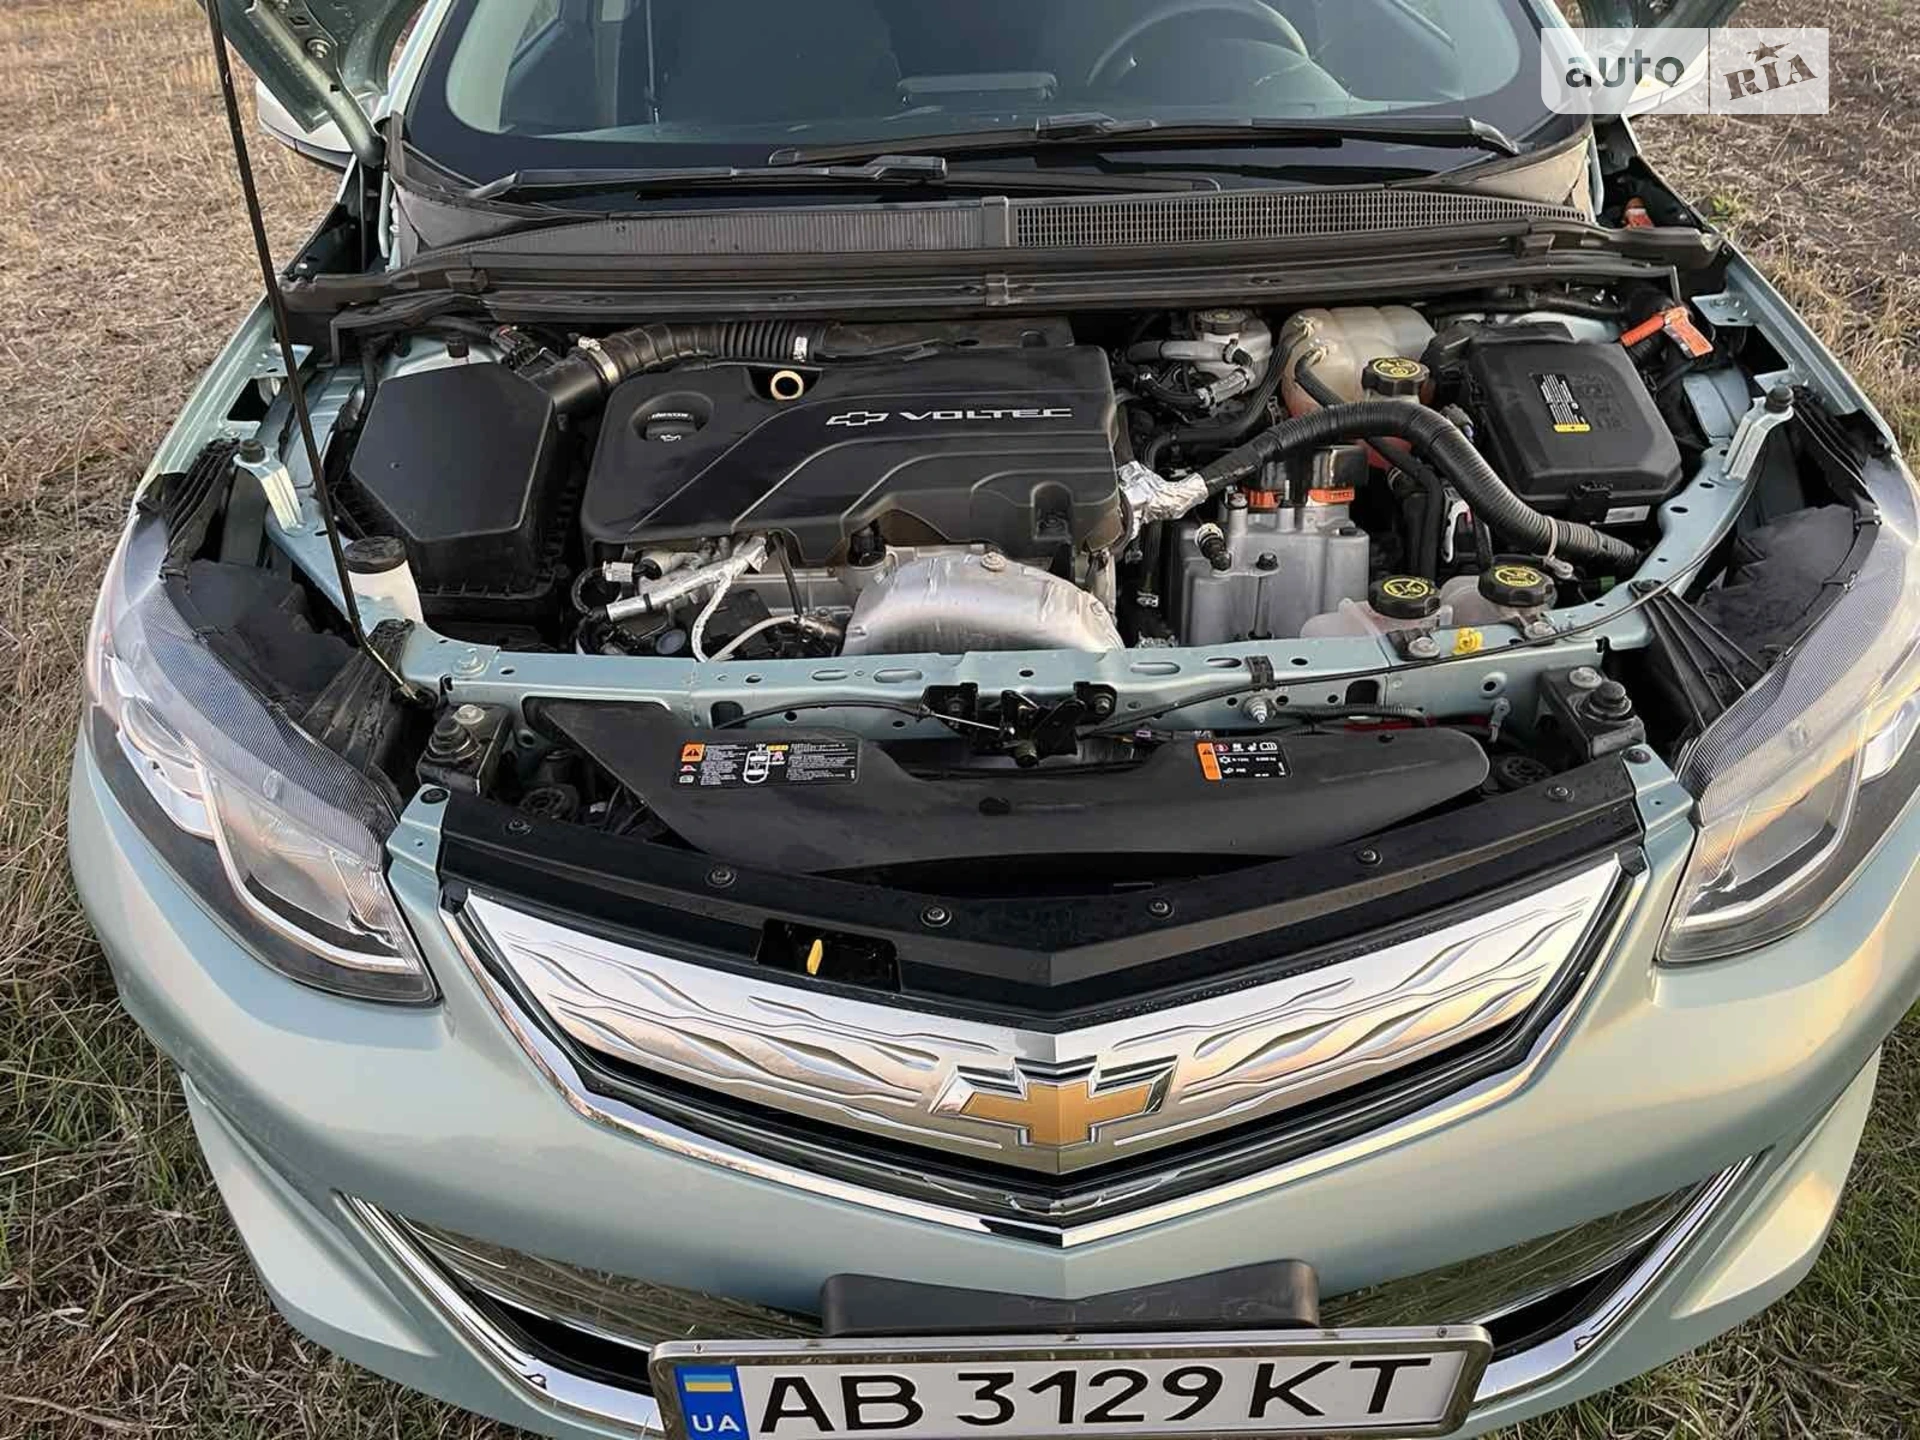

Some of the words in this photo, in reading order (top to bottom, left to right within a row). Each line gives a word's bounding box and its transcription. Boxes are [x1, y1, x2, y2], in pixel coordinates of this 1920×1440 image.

[899, 407, 1073, 421] VOLTEC
[760, 1374, 924, 1433] AB
[956, 1366, 1223, 1426] 3129
[1248, 1358, 1432, 1418] KT
[691, 1414, 741, 1433] UA
